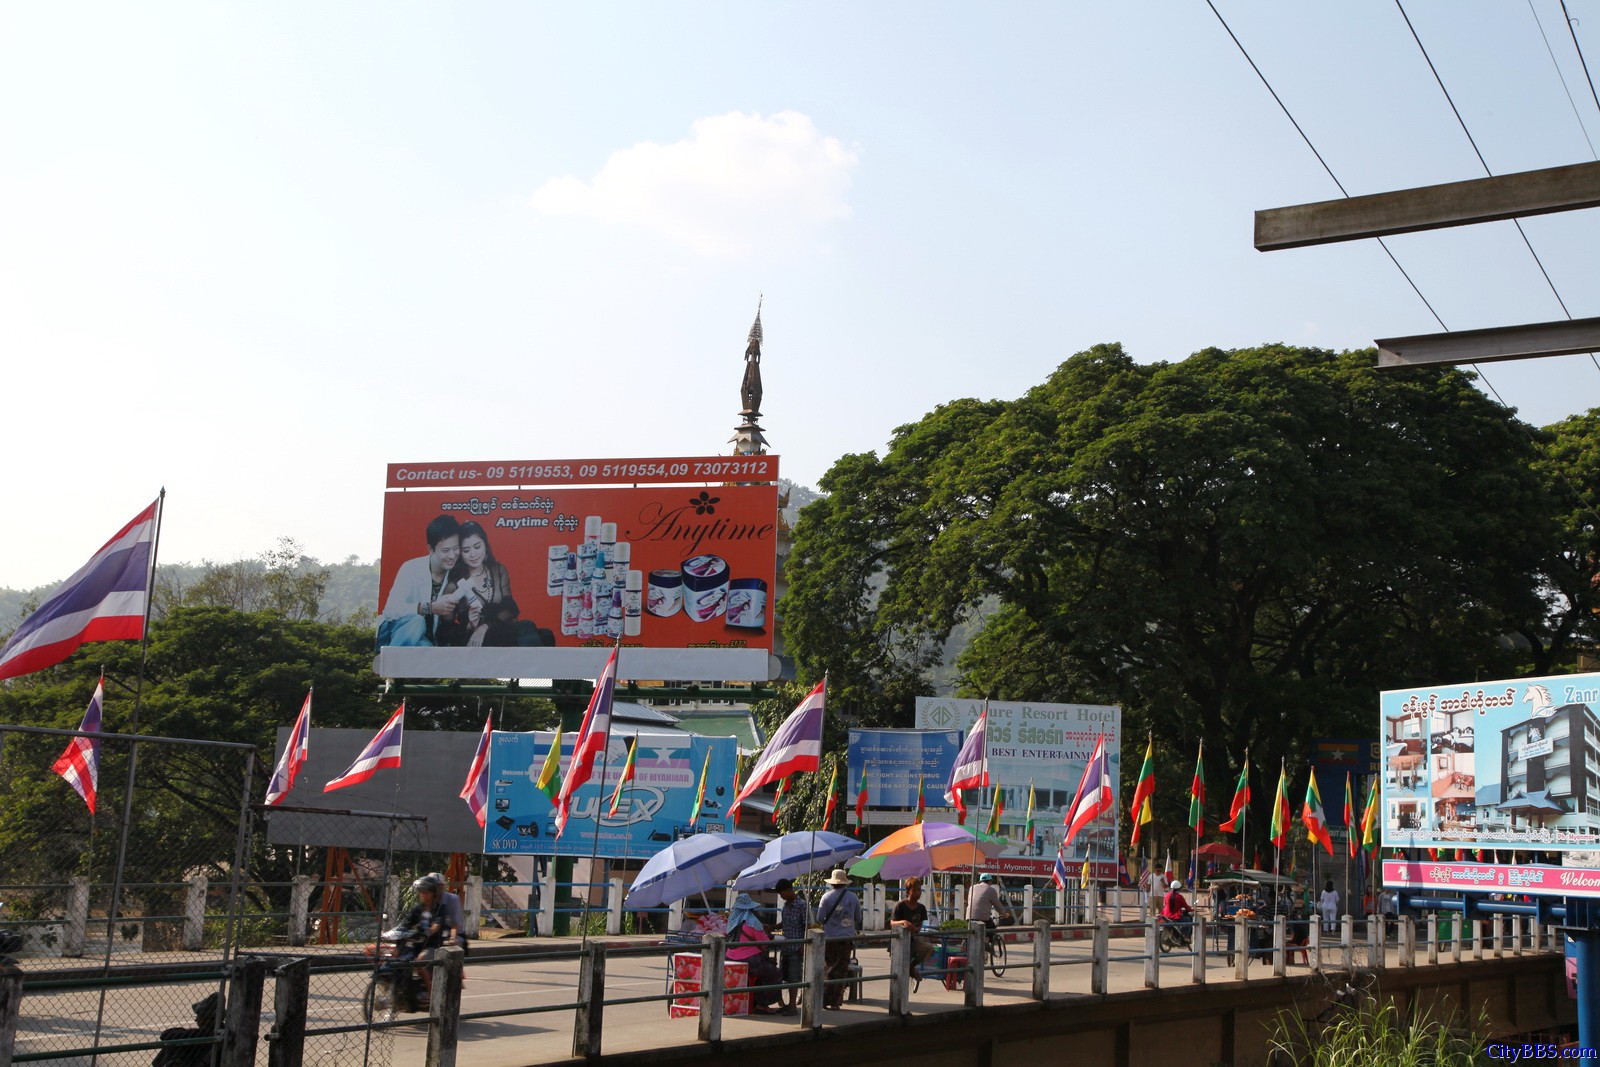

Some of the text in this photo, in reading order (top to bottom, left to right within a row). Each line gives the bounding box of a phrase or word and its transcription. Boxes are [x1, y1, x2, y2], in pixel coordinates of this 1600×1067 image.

[396, 468, 455, 480] Contact
[458, 469, 482, 480] us-
[486, 467, 505, 479] 09
[508, 466, 574, 479] 5119553,
[579, 465, 598, 477] 09
[693, 461, 768, 475] 73073112
[495, 516, 549, 529] Anytime
[625, 501, 774, 557] Anytime
[1021, 706, 1068, 721] Resort
[1077, 708, 1115, 723] Hotel
[992, 748, 1017, 757] BEST
[638, 773, 648, 782] OF
[649, 773, 690, 783] MYANMAR
[1004, 864, 1036, 872] Myanmar
